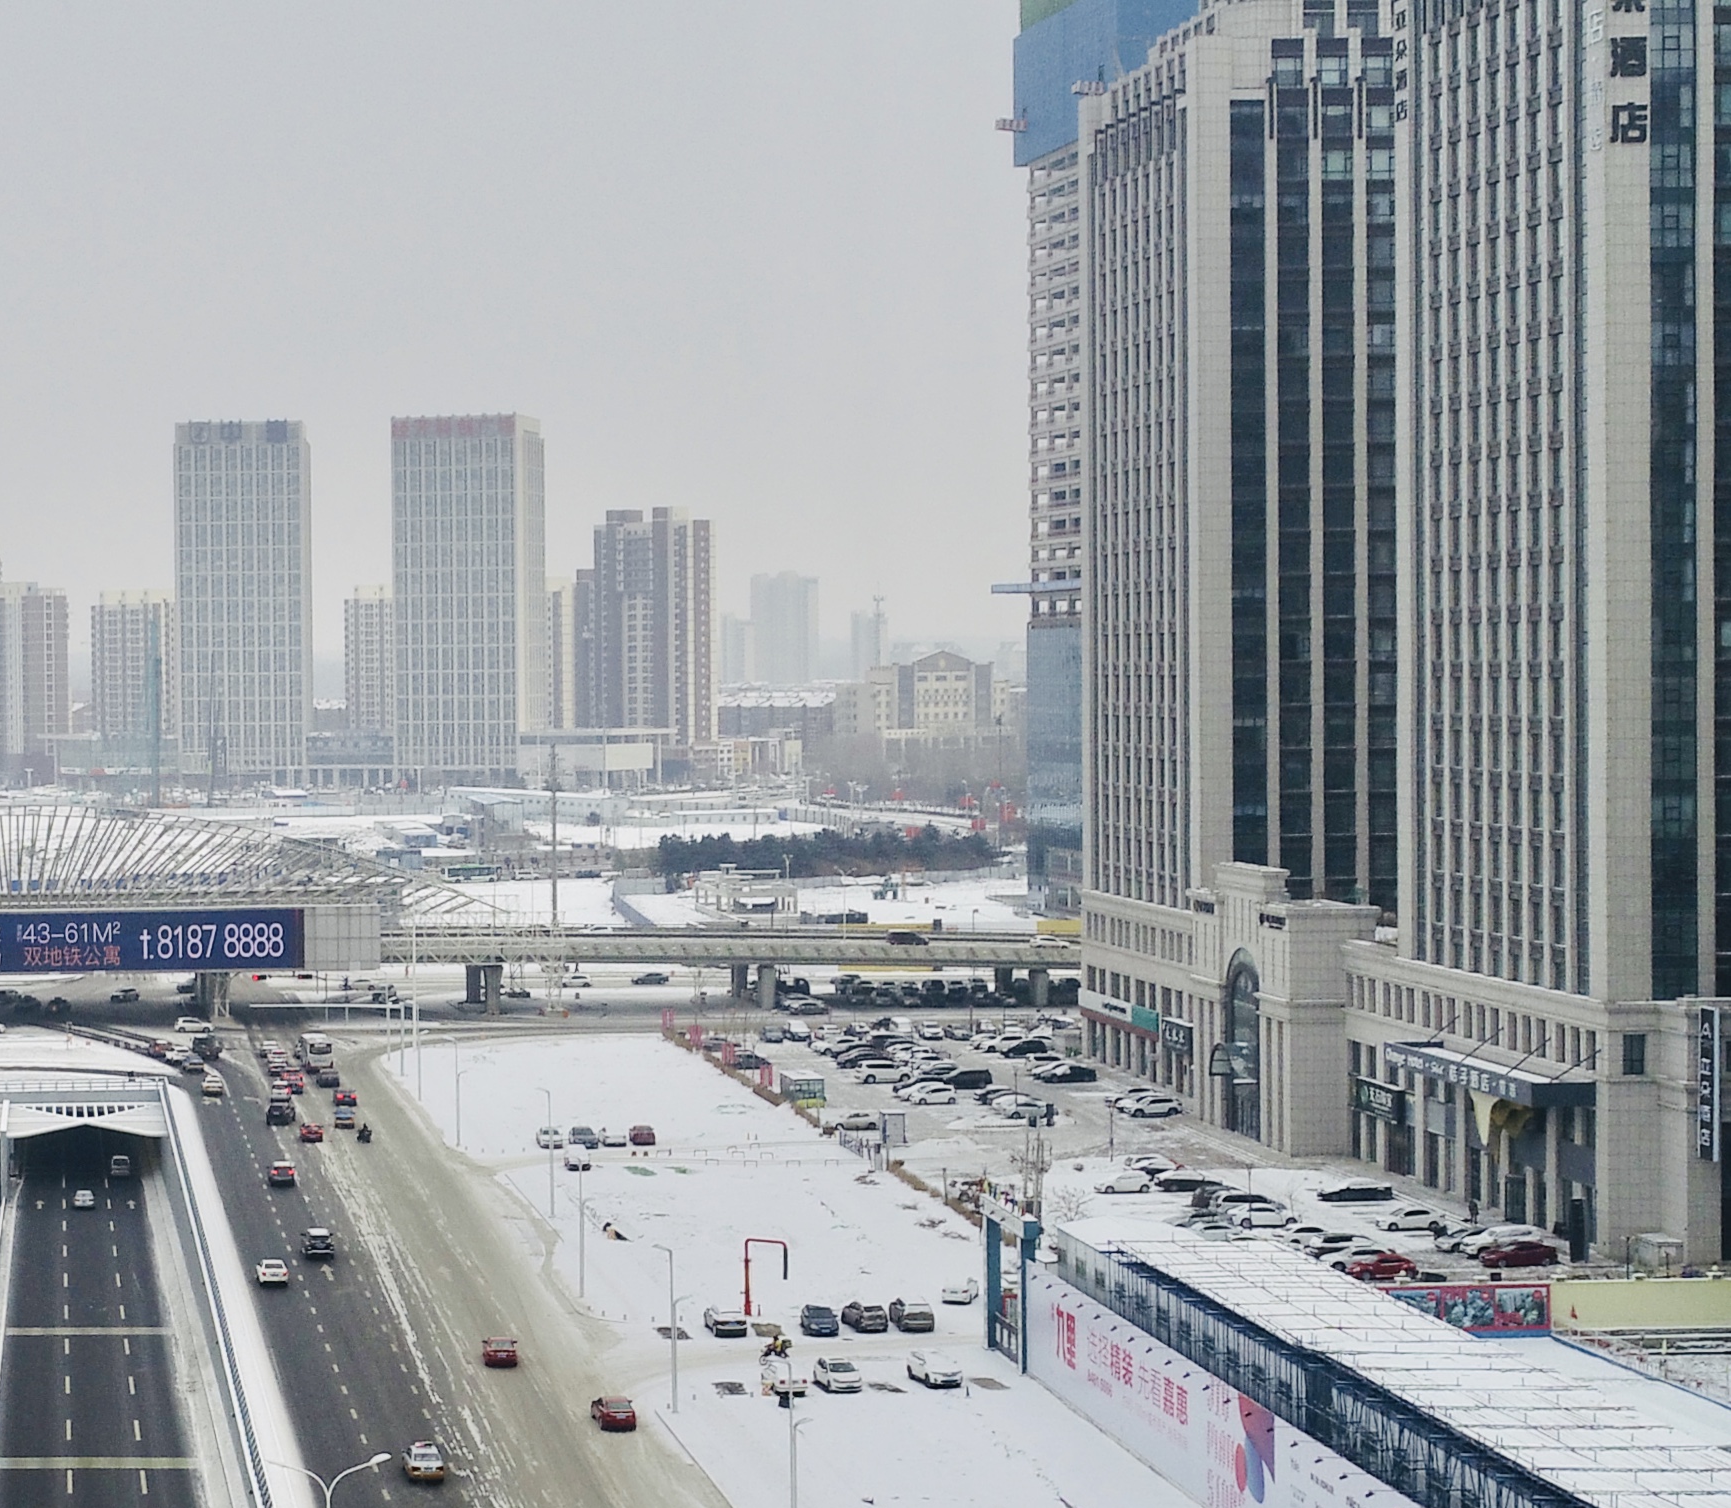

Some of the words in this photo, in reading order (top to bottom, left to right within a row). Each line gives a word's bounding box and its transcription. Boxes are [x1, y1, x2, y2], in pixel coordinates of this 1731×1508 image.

[224, 922, 284, 958] 8888
[23, 945, 121, 966] 双地铁公寓
